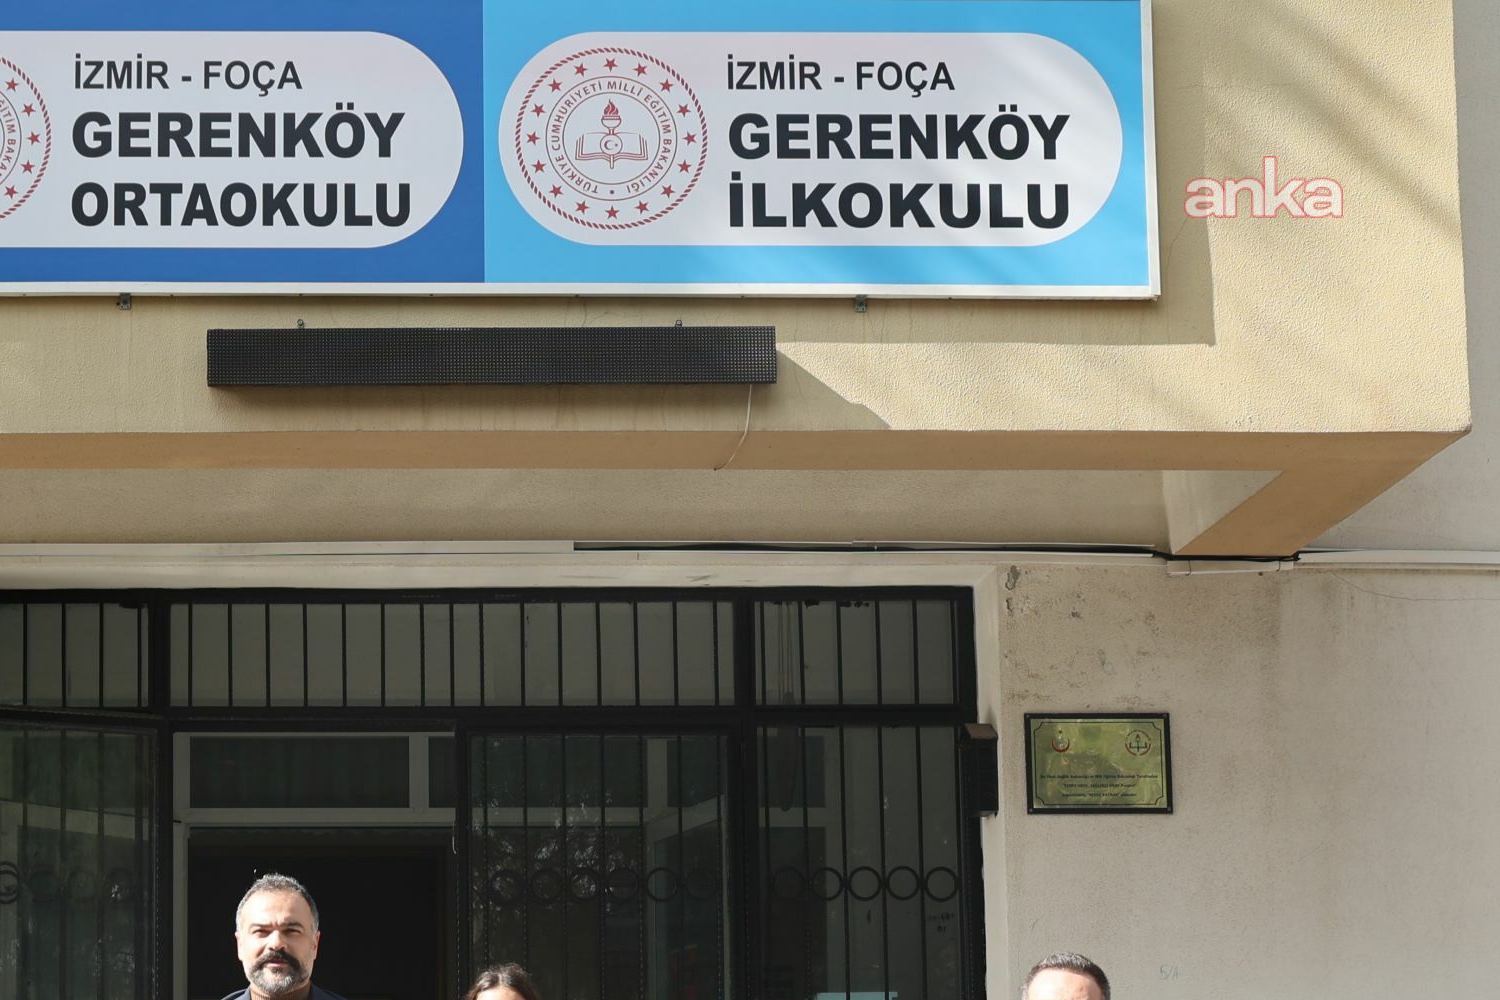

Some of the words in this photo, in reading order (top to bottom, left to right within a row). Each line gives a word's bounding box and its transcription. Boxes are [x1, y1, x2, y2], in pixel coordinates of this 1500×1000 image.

[74, 53, 170, 90] İZMİR
[203, 60, 303, 97] FOÇA
[727, 54, 823, 91] İZMİR
[856, 61, 956, 98] FOÇA
[71, 101, 406, 159] GERENKÖY
[551, 80, 602, 151] CUMHURİYETİ
[643, 94, 672, 135] EĞİTİM
[728, 103, 1071, 160] GERENKÖY
[554, 154, 599, 194] TÜRKİYE
[626, 138, 673, 194] BAKANLIĞI
[71, 181, 411, 228] ORTAOKULU
[729, 171, 1070, 229] İLKOKULU
